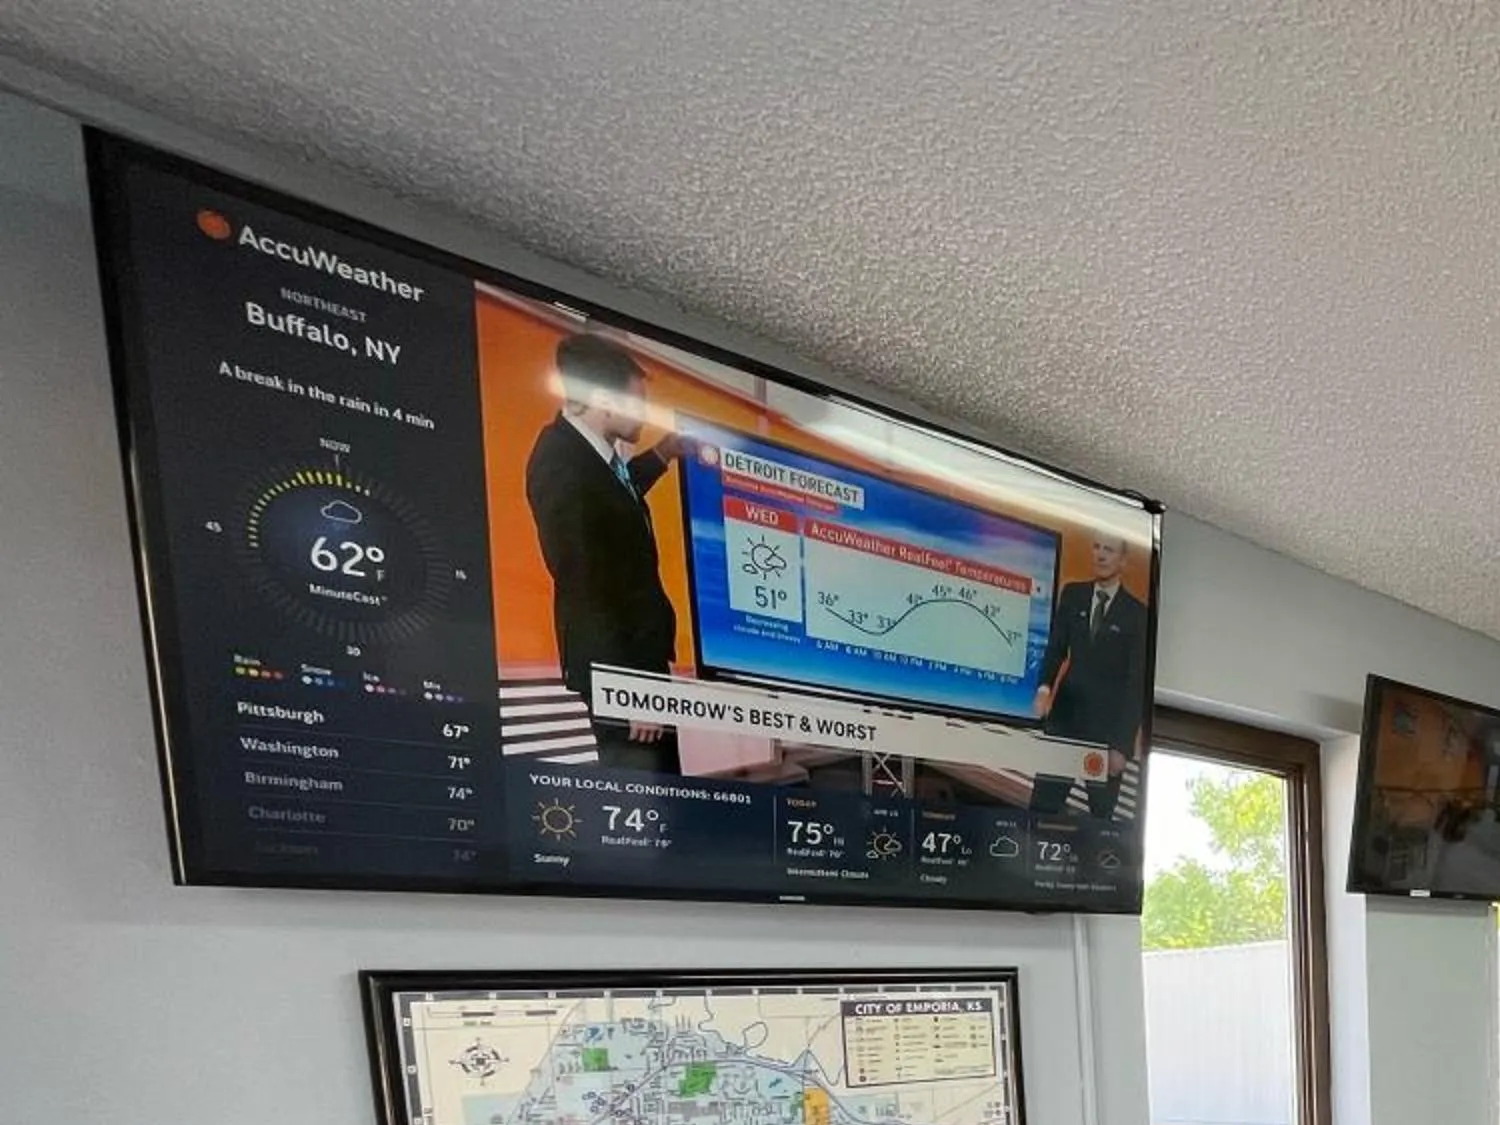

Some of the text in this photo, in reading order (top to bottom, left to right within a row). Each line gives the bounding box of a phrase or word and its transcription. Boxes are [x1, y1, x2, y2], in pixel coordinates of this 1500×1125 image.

[238, 225, 425, 302] AccuWeather
[281, 287, 367, 323] NORTHEAST
[245, 302, 401, 366] Buffalo, NY
[219, 360, 435, 430] A break in the rain in 4 min
[725, 453, 788, 482] DETROIT
[790, 471, 858, 503] FORECAST
[744, 503, 779, 526] WED
[811, 522, 896, 555] AccuWeather
[953, 562, 1027, 593] Temperatures
[755, 585, 787, 610] 51°
[817, 591, 840, 607] 36°
[848, 609, 869, 626] 33°
[236, 701, 325, 725] Pittsburgh
[601, 686, 877, 742] TOMORROW'S BEST & WORST
[240, 736, 339, 759] Washington
[244, 770, 343, 792] Birmingham
[529, 773, 751, 804] YOUR LOCAL CONDITIONS: 66801
[248, 805, 326, 824] Charlotte
[602, 805, 659, 832] 74°
[788, 821, 834, 845] 75°
[922, 832, 961, 853] 47°
[533, 853, 570, 867] Sunny
[1037, 841, 1071, 862] 72°
[855, 1003, 881, 1015] CITY
[885, 1003, 901, 1014] OF
[906, 1001, 962, 1013] EMPORIA,
